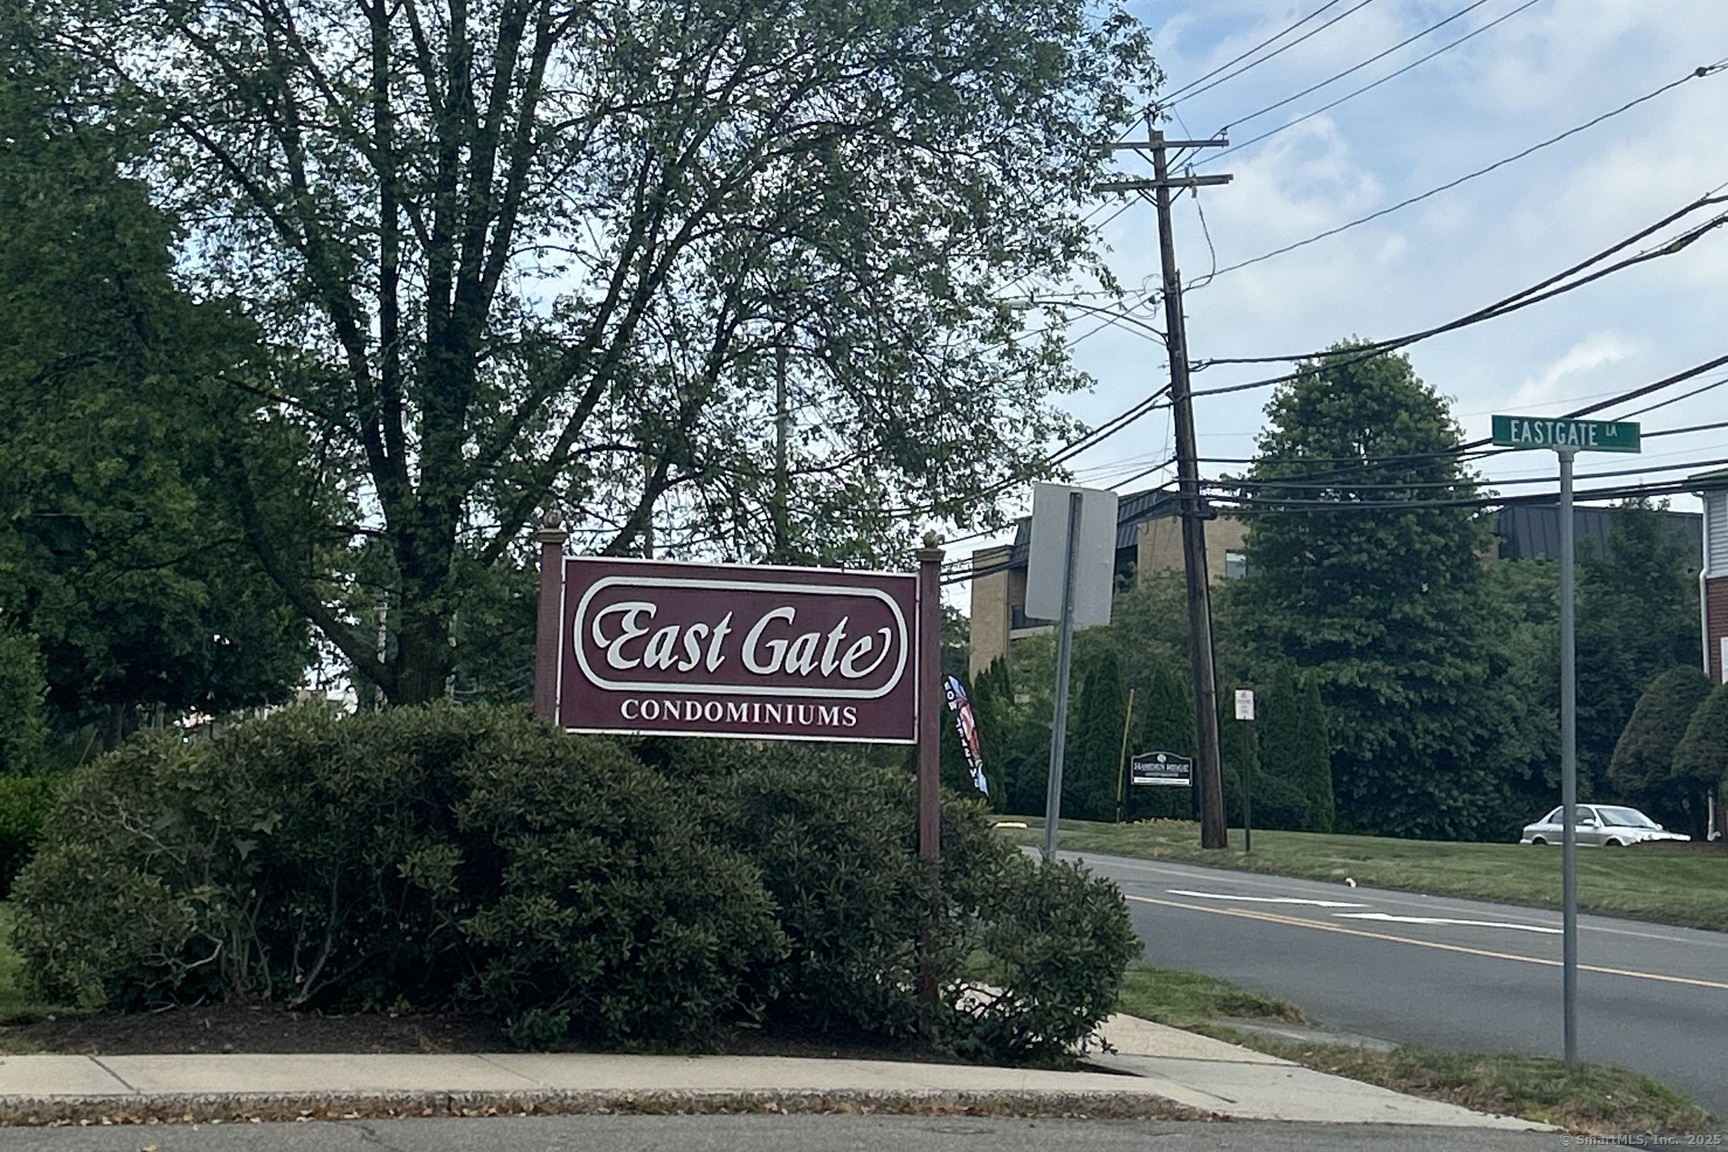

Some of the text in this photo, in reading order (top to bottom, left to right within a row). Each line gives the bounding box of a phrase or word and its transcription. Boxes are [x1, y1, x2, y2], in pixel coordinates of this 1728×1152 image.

[1510, 420, 1617, 446] EASTGATE LA
[592, 601, 892, 679] East Gate
[620, 699, 857, 727] CONDOMINIUMS
